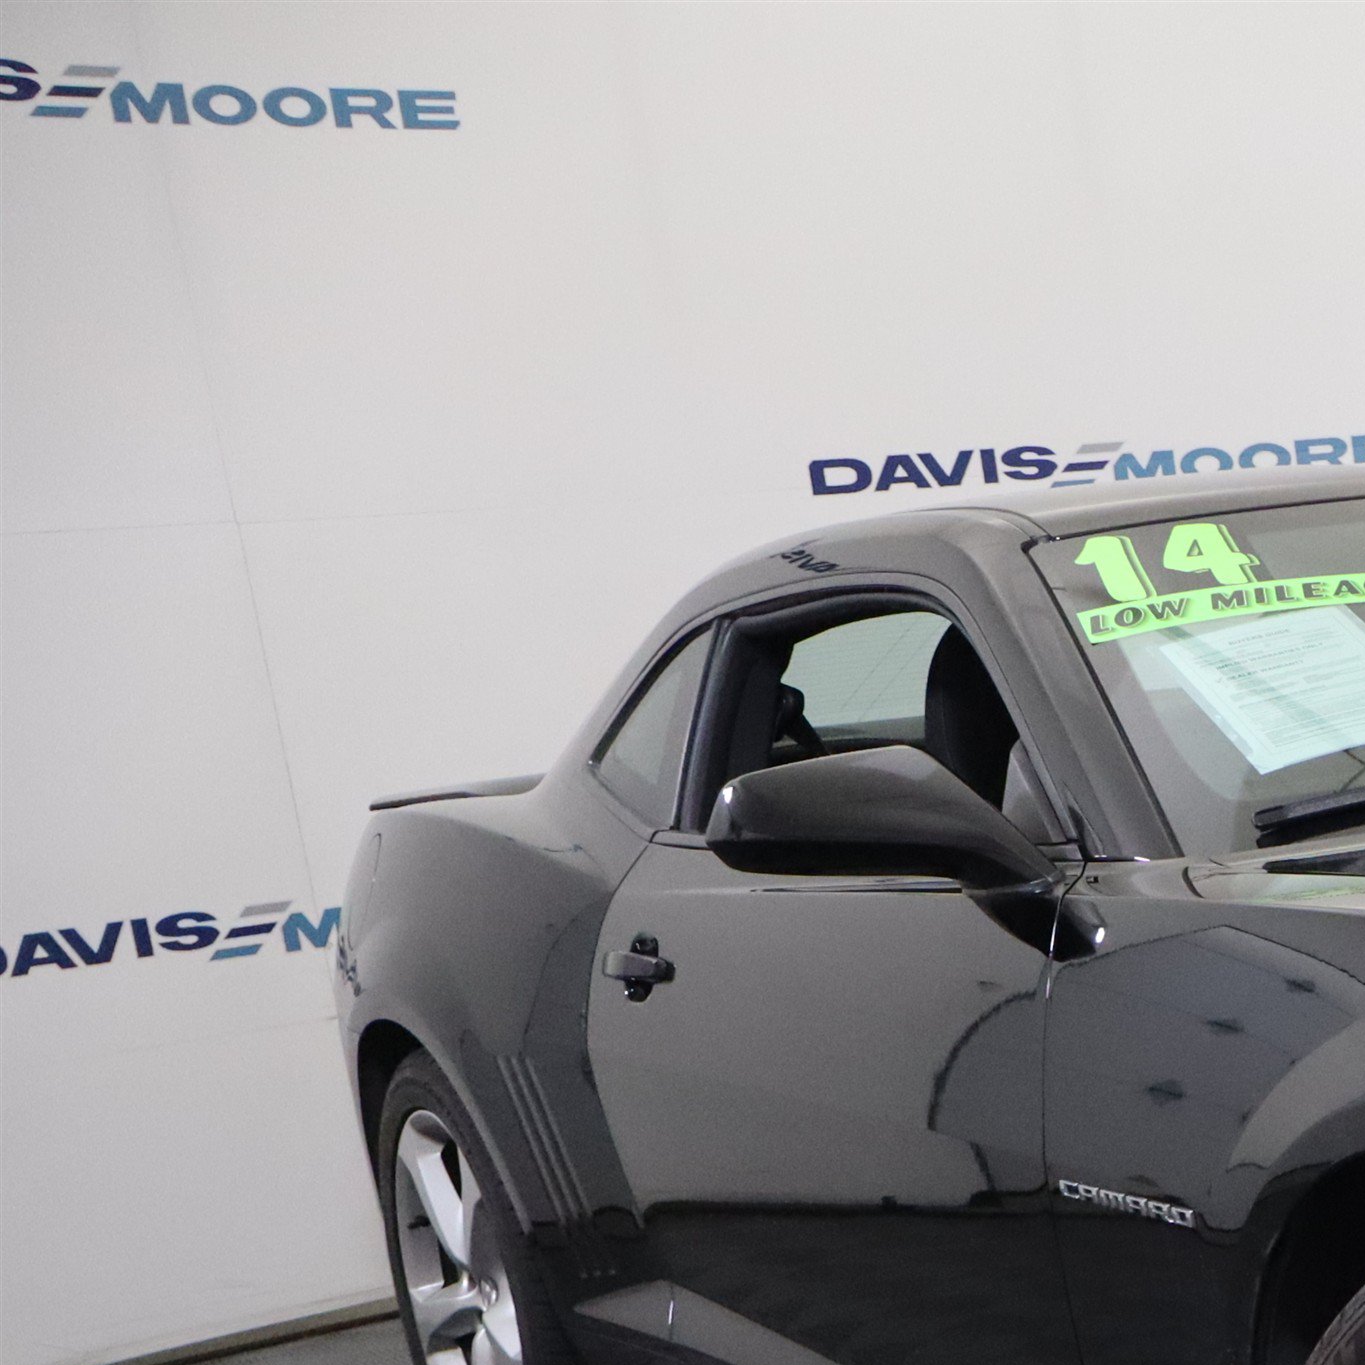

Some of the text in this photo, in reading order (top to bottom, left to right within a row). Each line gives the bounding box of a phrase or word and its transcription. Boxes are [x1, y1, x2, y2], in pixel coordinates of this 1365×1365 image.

[109, 80, 461, 130] MOORE
[807, 445, 1059, 496] DAVIS
[1074, 523, 1259, 602] 14
[1089, 597, 1191, 636] LOW
[0, 911, 220, 978] AVIS
[1058, 1179, 1196, 1229] CAMARO
